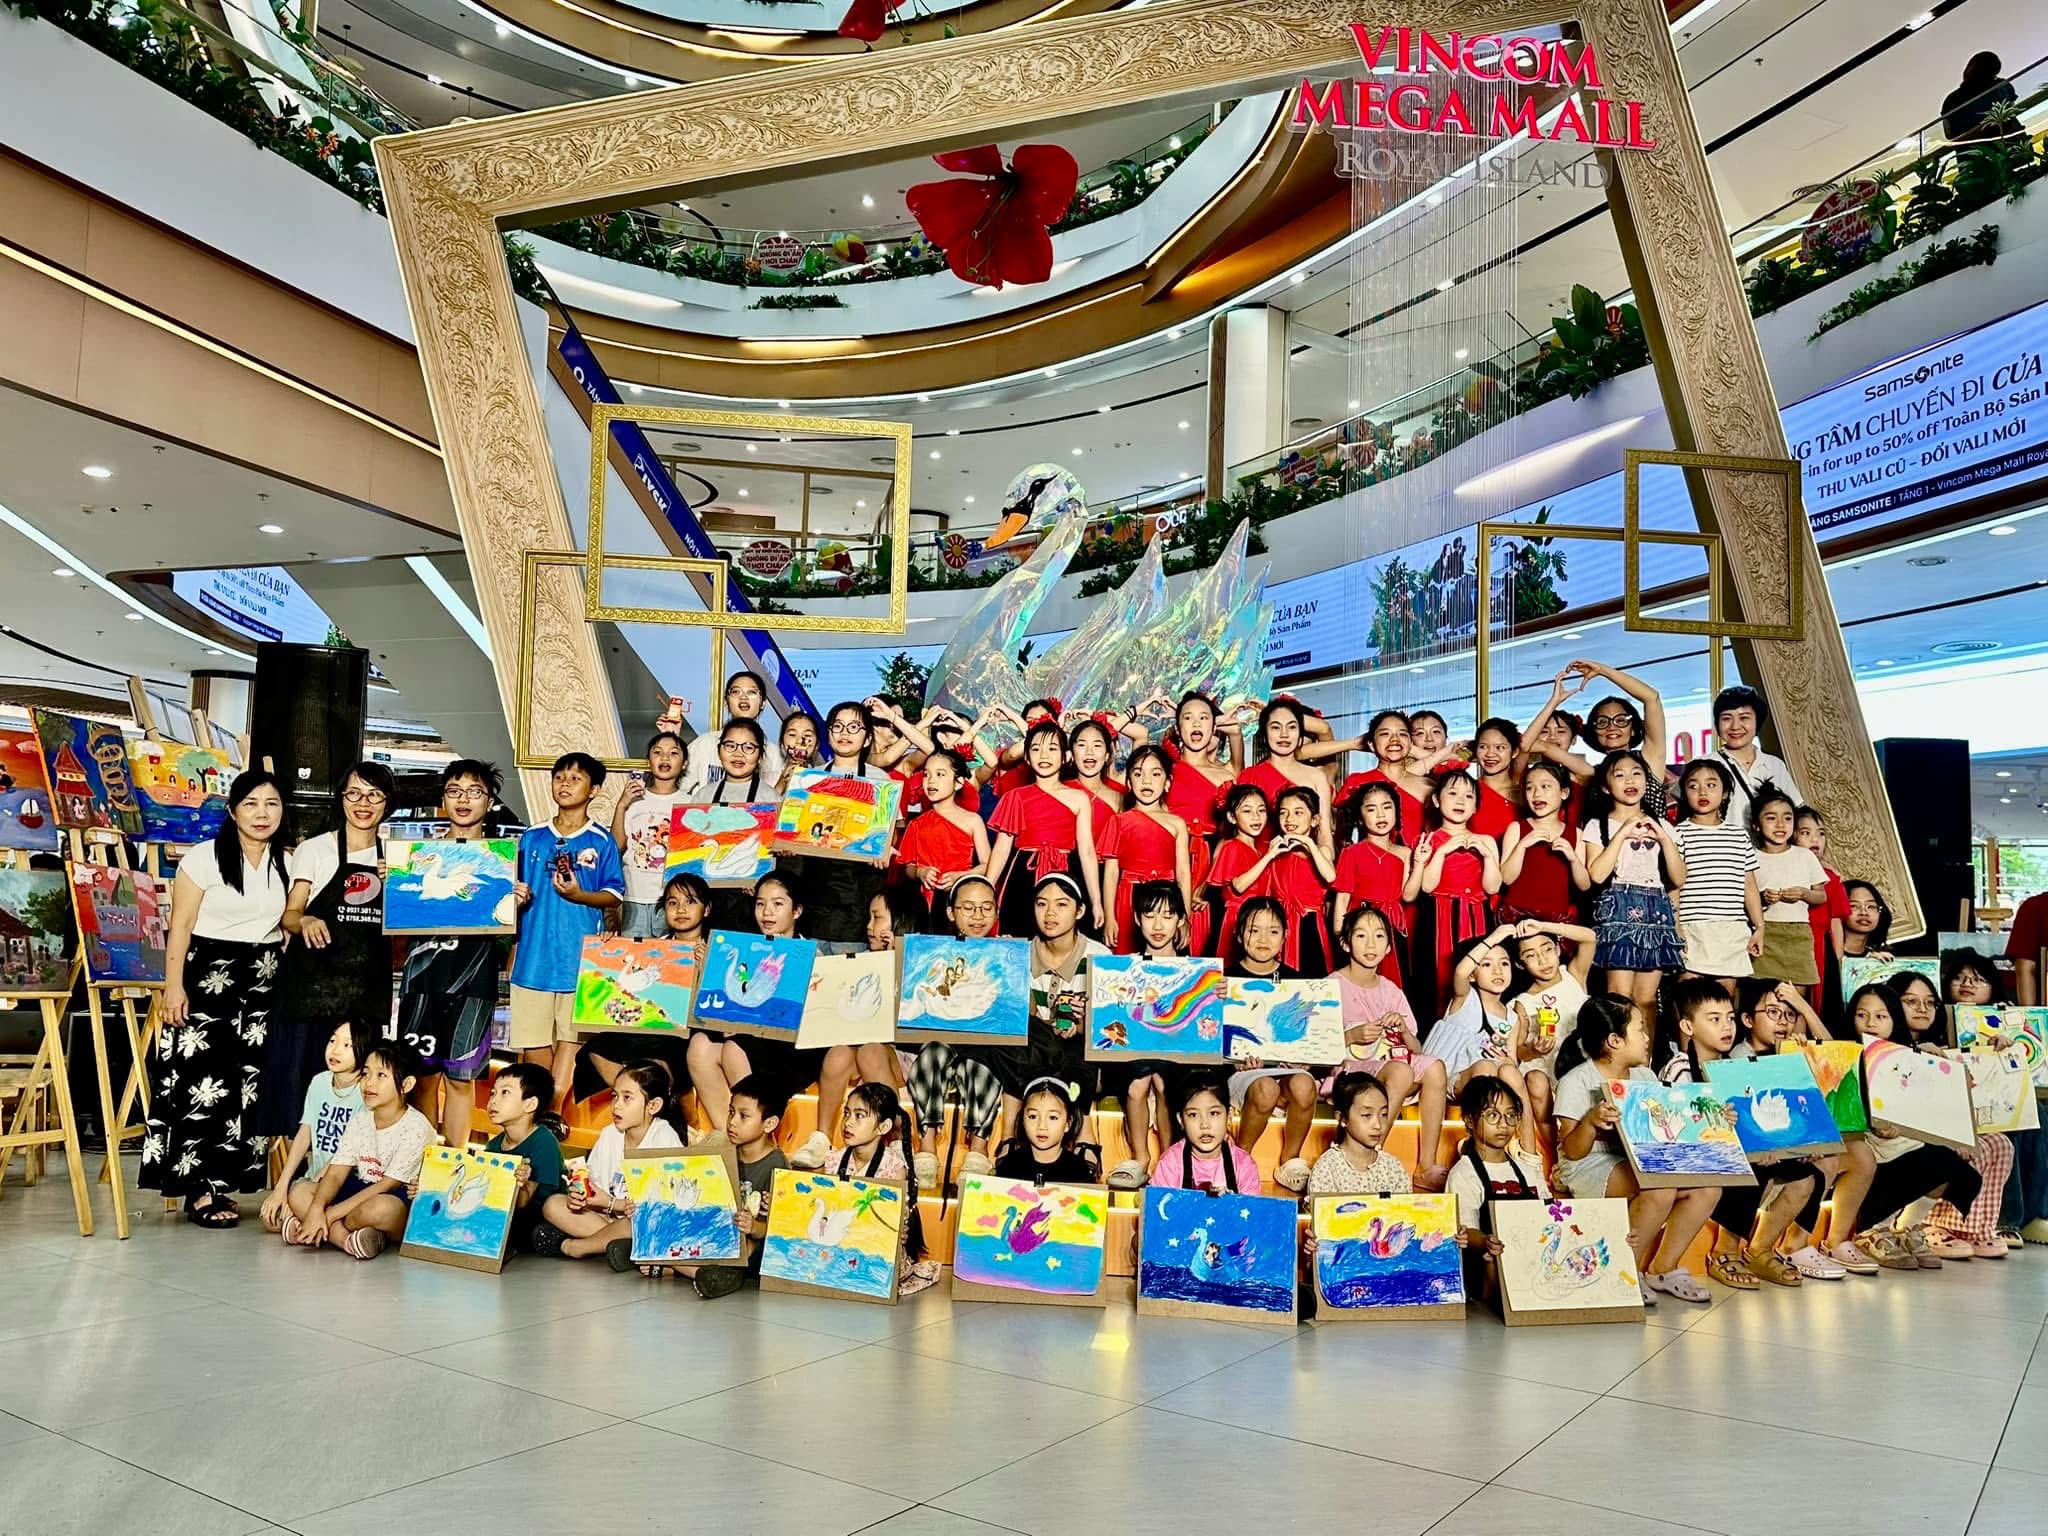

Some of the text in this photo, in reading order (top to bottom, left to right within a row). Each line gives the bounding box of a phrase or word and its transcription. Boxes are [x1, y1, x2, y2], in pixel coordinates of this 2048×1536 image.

[1349, 23, 1604, 89] VINCOM
[1292, 78, 1659, 150] MEGA MALL
[1339, 140, 1612, 190] ROYAL ISLAND
[1816, 421, 1861, 453] TẦM
[1866, 386, 1955, 436] CHUYẾN
[1961, 376, 1984, 402] ĐI
[1992, 352, 2042, 390] CỦA
[1865, 353, 1964, 402] Samsonite
[1817, 478, 1847, 499] THU
[1849, 467, 1882, 488] VALI
[1885, 458, 1906, 478] CŨ
[1953, 432, 1988, 455] VALI
[1992, 416, 2026, 443] MỚI
[1824, 458, 1842, 472] for
[1845, 451, 1862, 466] up
[1866, 445, 1880, 458] to
[1883, 431, 1913, 452] 50%
[1917, 420, 1939, 440] off
[1942, 410, 1980, 431] Toàn
[1984, 398, 2005, 417] Bộ
[2009, 388, 2040, 408] Sản
[1832, 496, 1892, 522] SAMSONITE
[1937, 471, 1973, 490] Vincom
[1974, 463, 2002, 479] Mega
[2004, 455, 2025, 471] Mall
[1294, 599, 1318, 619] BẠN
